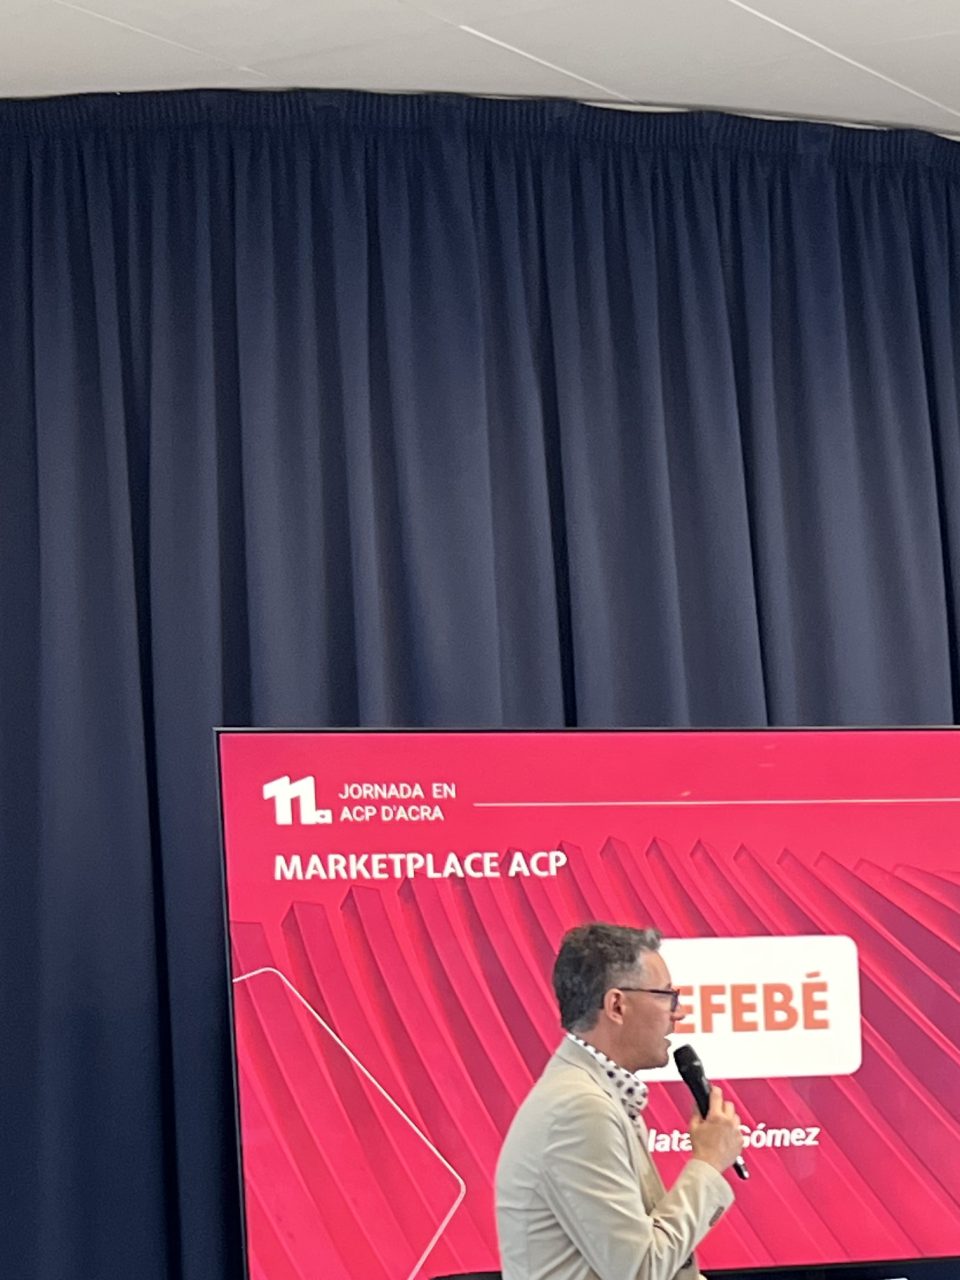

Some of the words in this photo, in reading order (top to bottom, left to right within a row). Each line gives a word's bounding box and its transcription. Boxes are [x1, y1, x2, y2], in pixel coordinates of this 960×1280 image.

[338, 783, 425, 800] JORNADA
[431, 783, 456, 799] EN
[339, 806, 377, 822] ACP
[380, 804, 445, 822] D'ACRA
[274, 852, 500, 881] MARKETPLACE
[508, 851, 568, 877] ACP
[673, 971, 829, 1034] EFEBÉ
